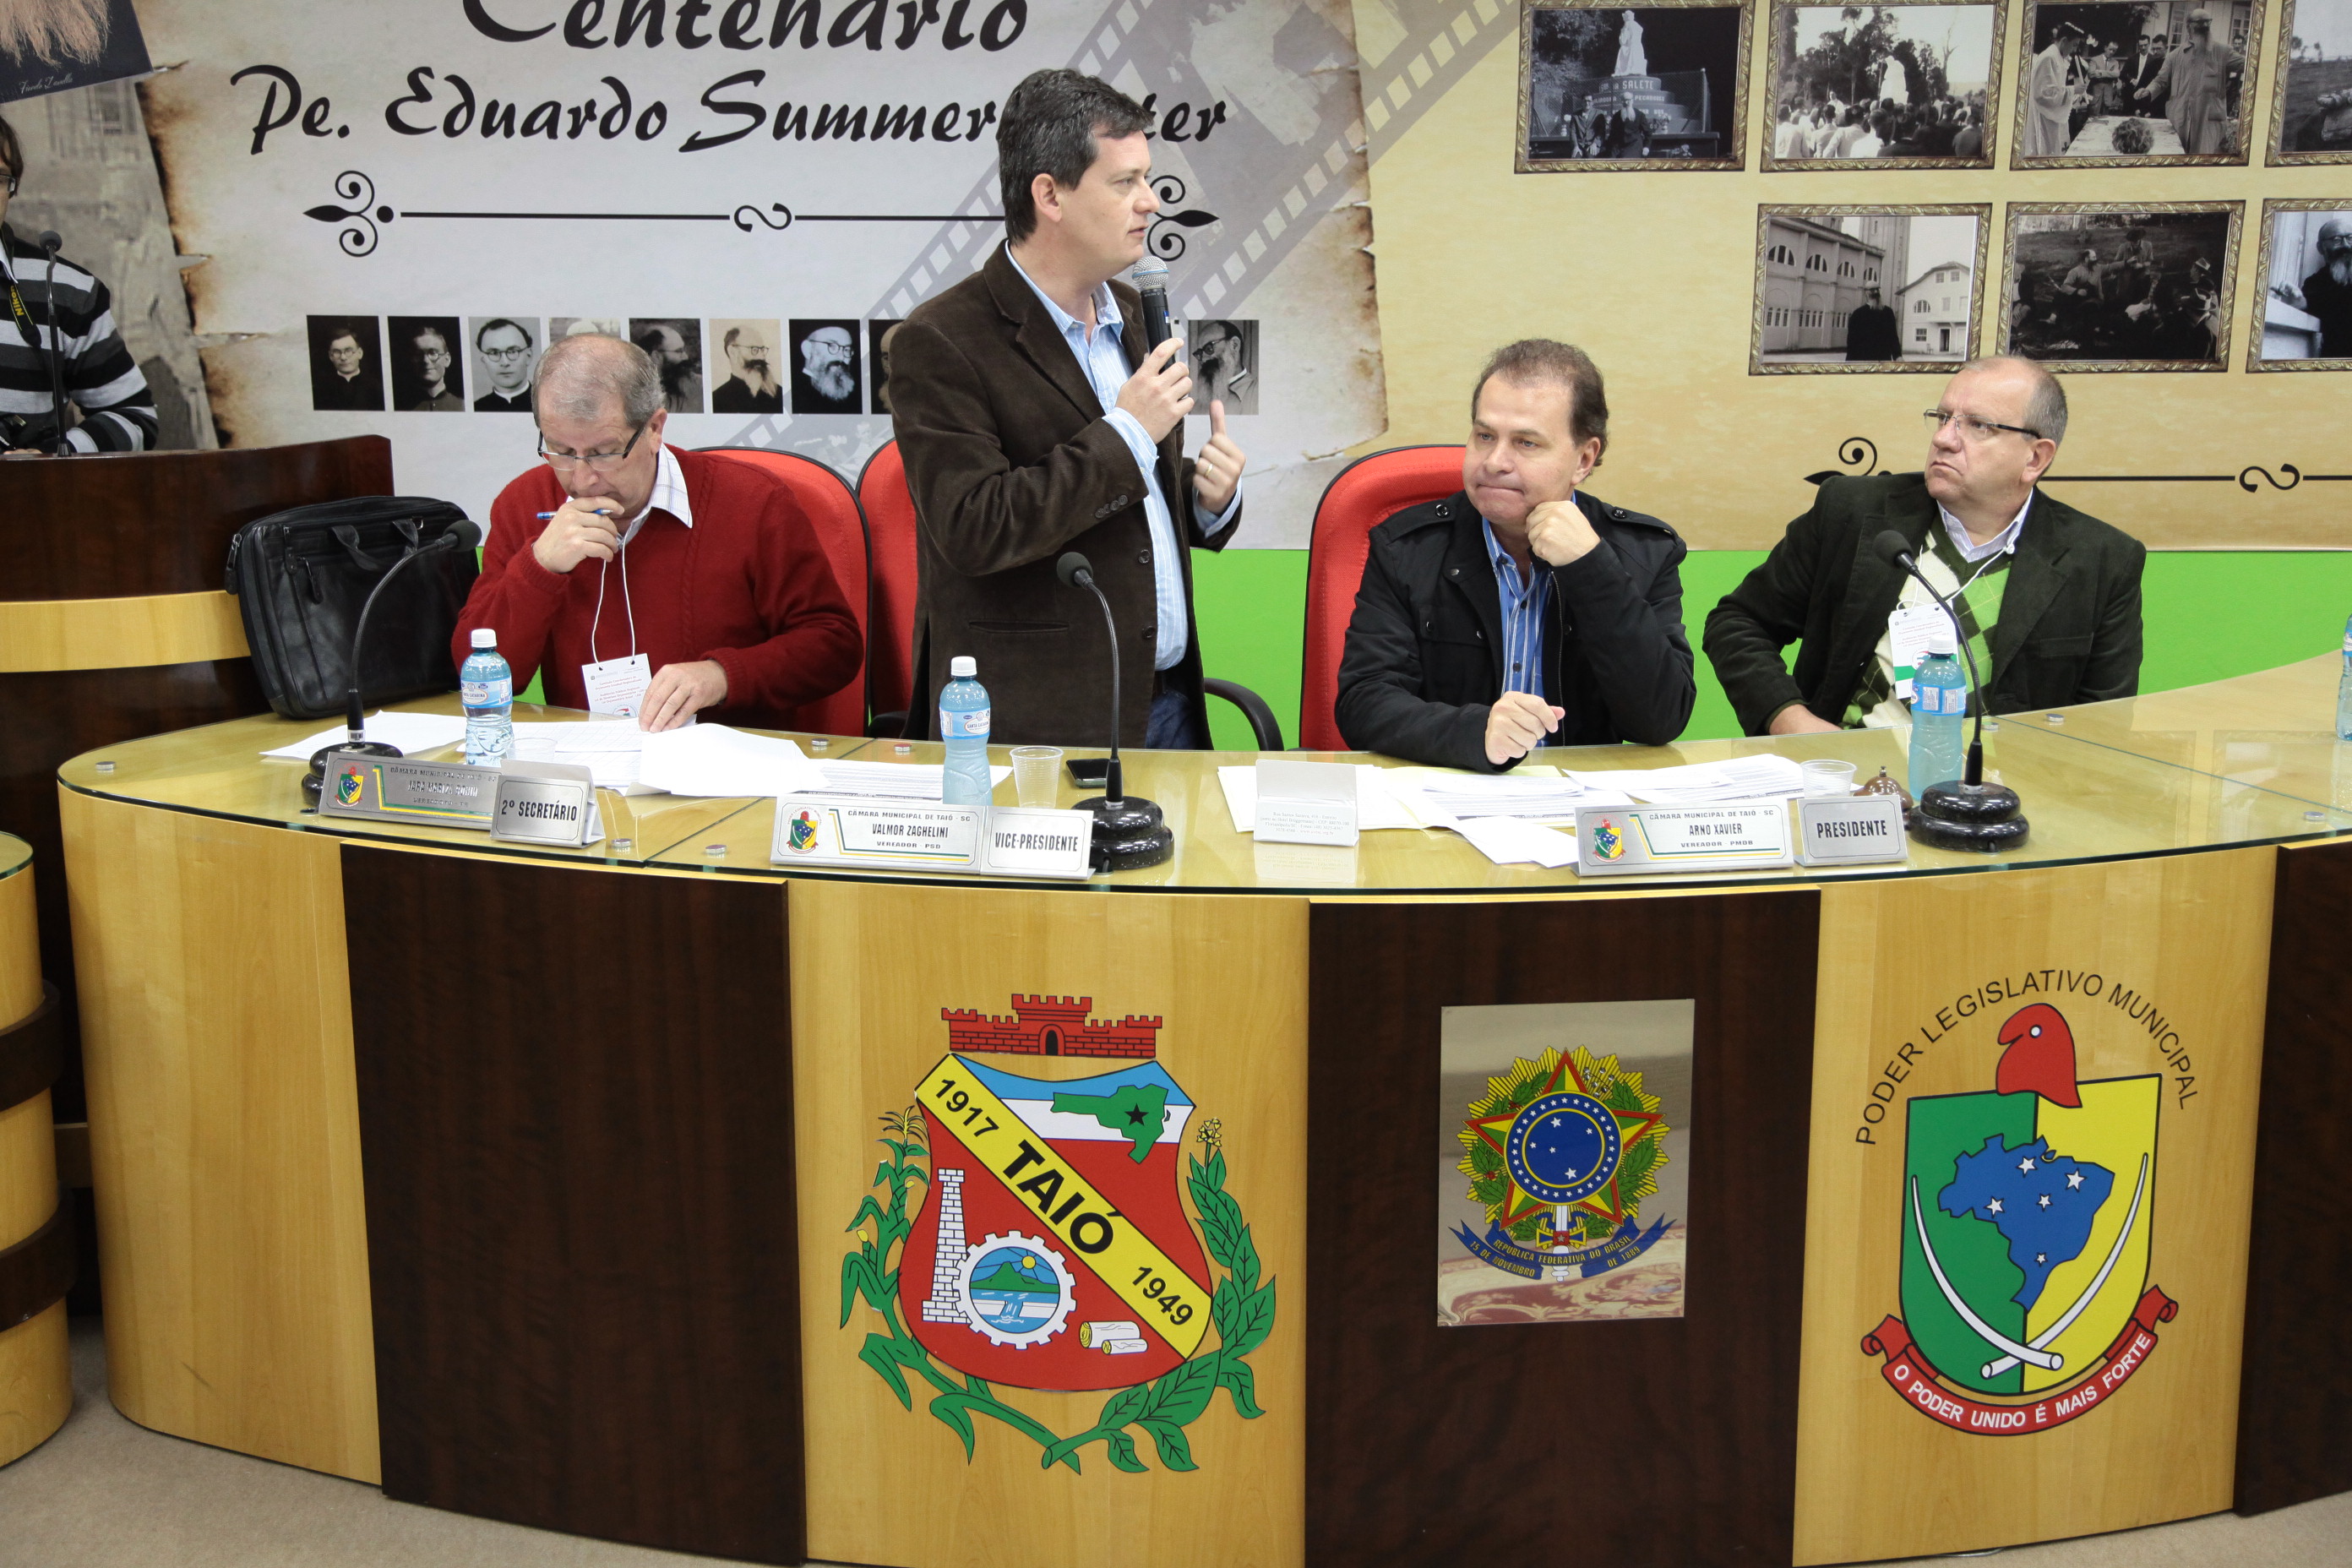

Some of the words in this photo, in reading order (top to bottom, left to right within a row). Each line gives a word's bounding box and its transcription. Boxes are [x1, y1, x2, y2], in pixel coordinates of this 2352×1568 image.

[1622, 79, 1654, 90] SALETE
[231, 64, 350, 155] Pe.
[384, 66, 667, 140] Eduardo
[678, 68, 1227, 153] Summerter
[10, 285, 24, 316] Nikon
[501, 799, 514, 815] 2º
[518, 799, 578, 821] SECRETÁRIO
[847, 808, 879, 818] CÂMARA
[882, 811, 923, 819] MUNICIPAL
[872, 823, 904, 836] VALMOR
[906, 825, 949, 839] ZAGHELINI
[994, 832, 1078, 852] VICE-PRESIDENTE
[1689, 825, 1711, 836] ARNO
[1714, 823, 1743, 836] XAVIER
[1816, 819, 1888, 839] PRESIDENTE
[1855, 1042, 1925, 1146] PODER
[1920, 969, 2104, 1044] LEGISLATIVO
[2107, 983, 2198, 1110] MUNICIPAL
[935, 1078, 1000, 1139] 1917
[1002, 1139, 1124, 1255] TAIÓ
[1470, 1240, 1481, 1251] 15
[1479, 1249, 1491, 1260] DE
[1492, 1255, 1535, 1277] NOVEMBRO
[1607, 1257, 1618, 1268] DE
[1620, 1246, 1641, 1261] 1889
[1493, 1239, 1535, 1261] REPUBLICA
[1538, 1253, 1586, 1265] FEDERATIVA
[1589, 1249, 1602, 1259] DO
[1603, 1235, 1632, 1254] BRASIL
[1131, 1266, 1194, 1326] 1949
[1894, 1364, 1909, 1380] O
[1908, 1380, 1964, 1423] PODER
[1970, 1410, 2026, 1429] UNIDO
[2034, 1403, 2047, 1424] É
[2055, 1386, 2098, 1418] MAIS
[2102, 1332, 2151, 1390] FORTE
